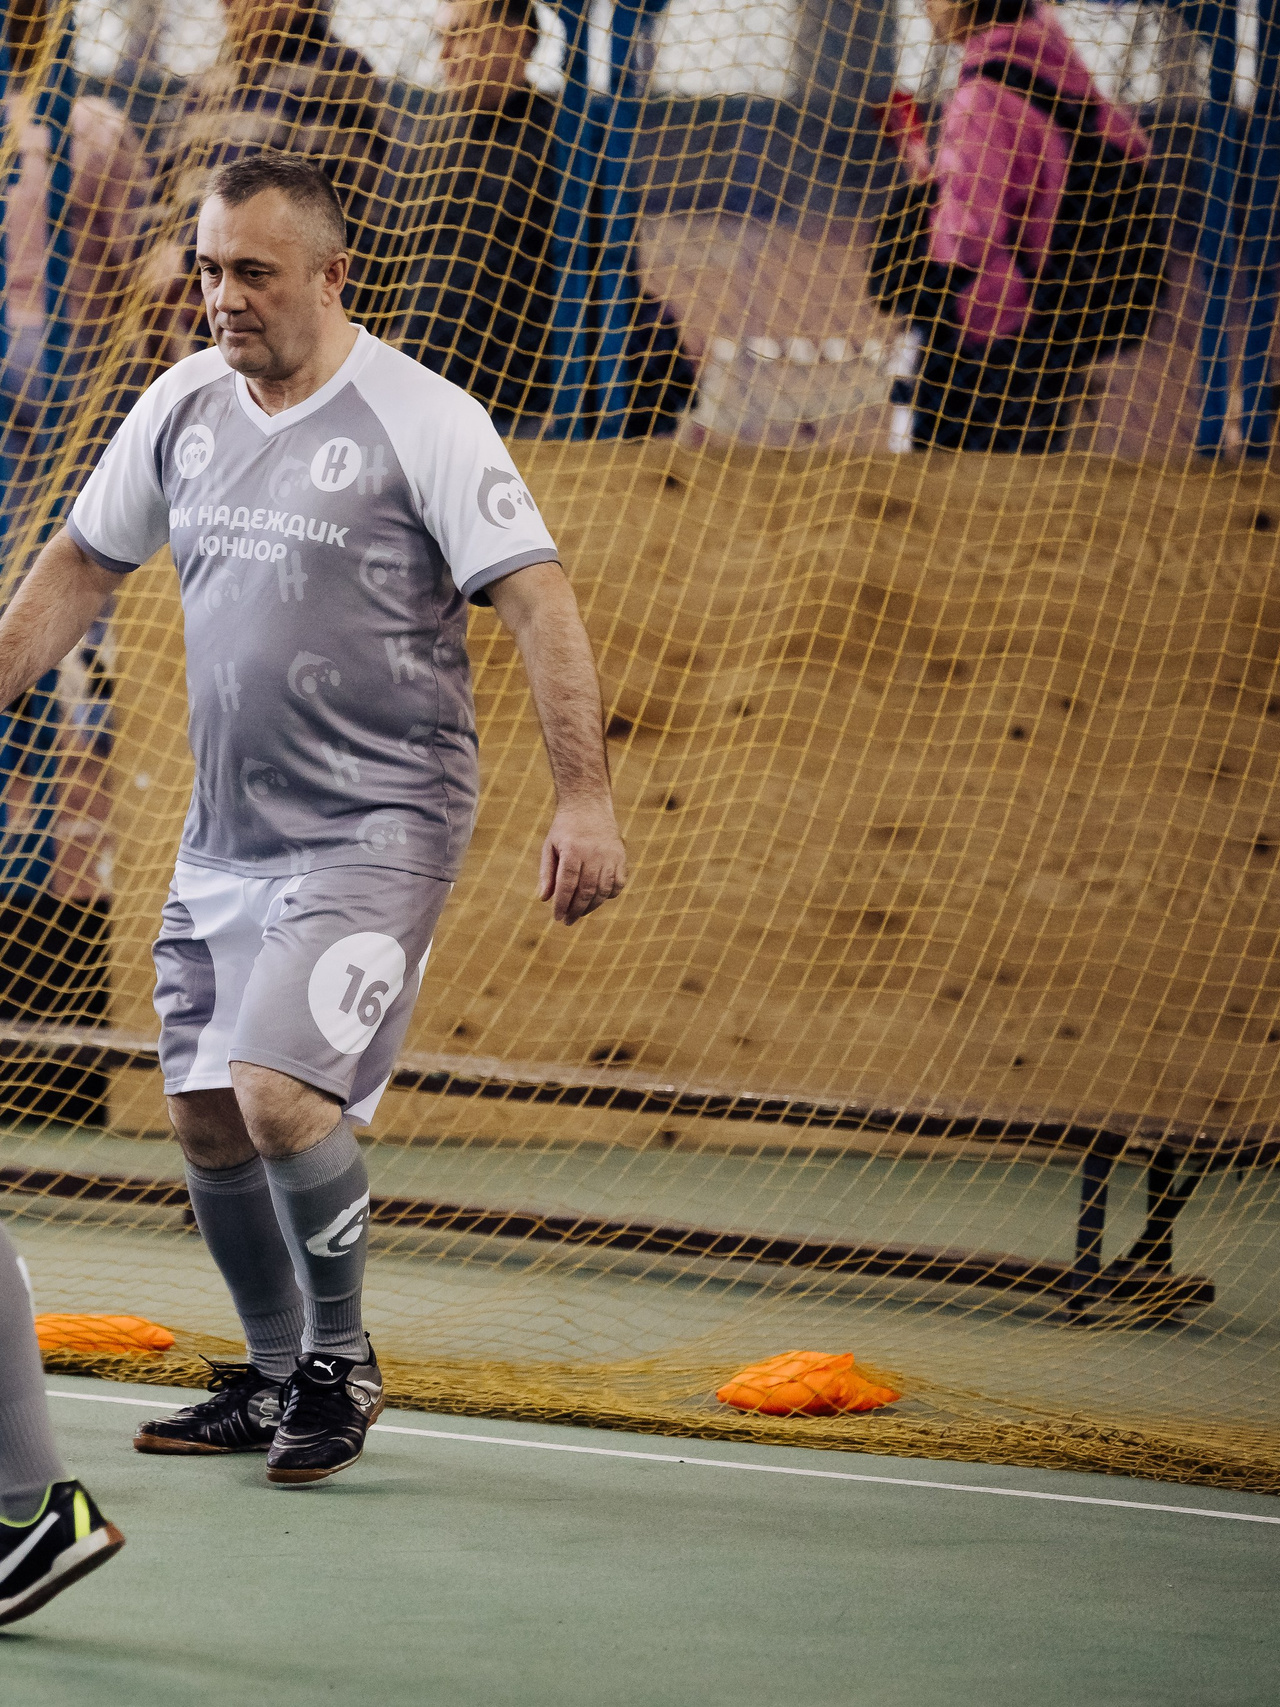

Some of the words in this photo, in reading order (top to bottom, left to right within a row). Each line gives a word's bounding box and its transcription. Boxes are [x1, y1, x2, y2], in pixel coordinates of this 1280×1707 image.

[197, 505, 350, 548] НАДЕЖДИК
[199, 535, 287, 562] ЮНИОР
[338, 963, 390, 1027] 16
